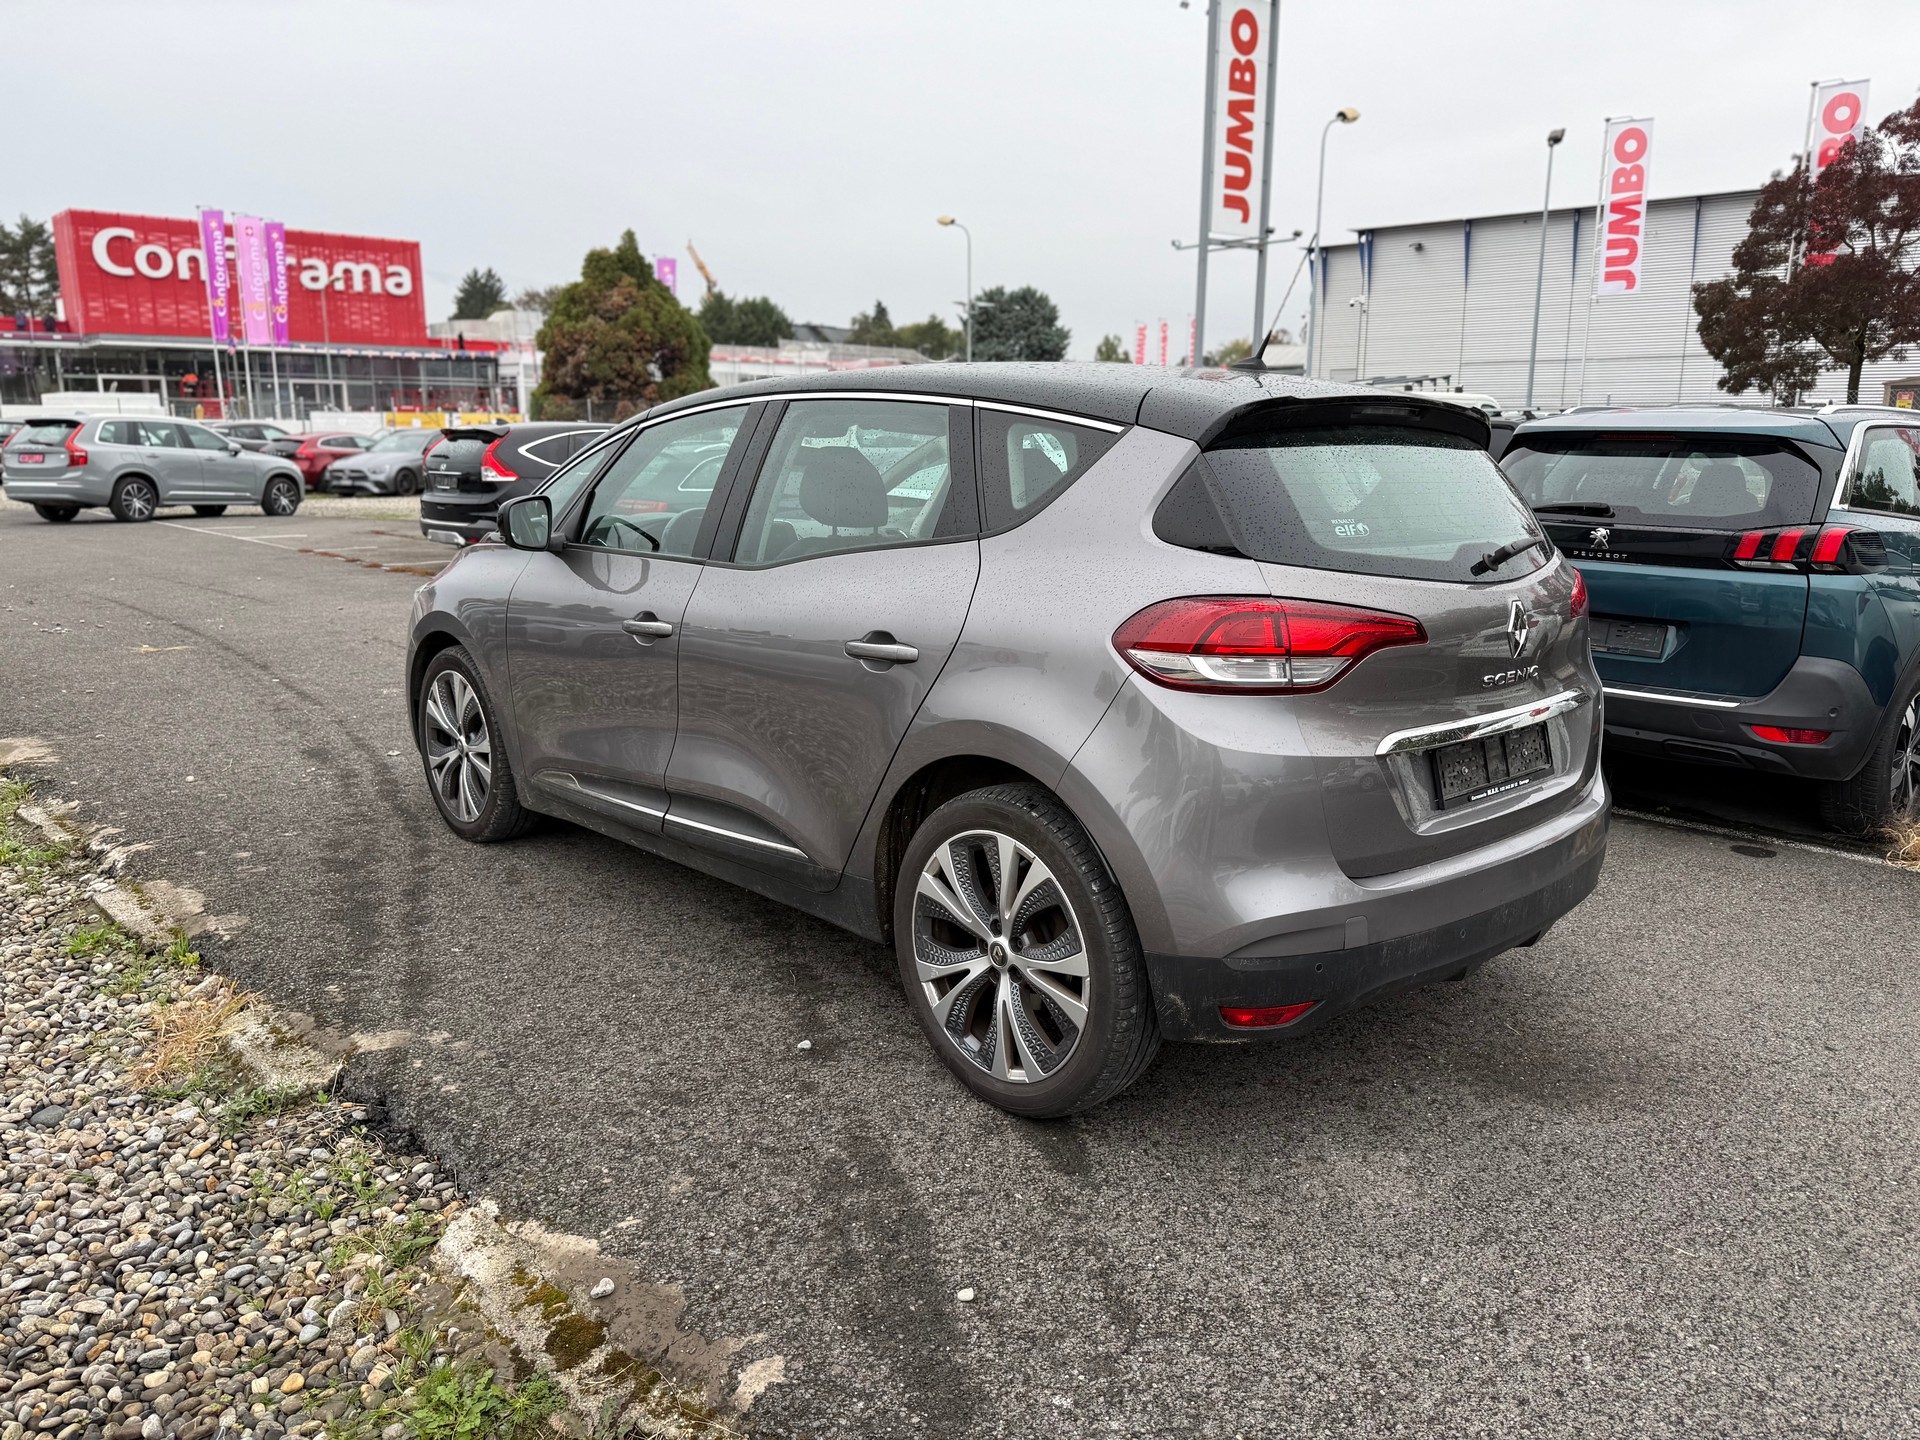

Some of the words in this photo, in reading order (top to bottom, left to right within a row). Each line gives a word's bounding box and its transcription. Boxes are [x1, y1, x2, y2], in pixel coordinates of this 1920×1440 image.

[1223, 8, 1259, 224] JUMBO
[1604, 127, 1648, 290] JUMBO
[91, 227, 413, 297] Conama
[212, 230, 227, 318] Conforama
[273, 241, 288, 324] Conforama
[1334, 524, 1356, 536] elf
[1573, 550, 1628, 559] PEUGEOT
[1482, 664, 1539, 688] SCENIC
